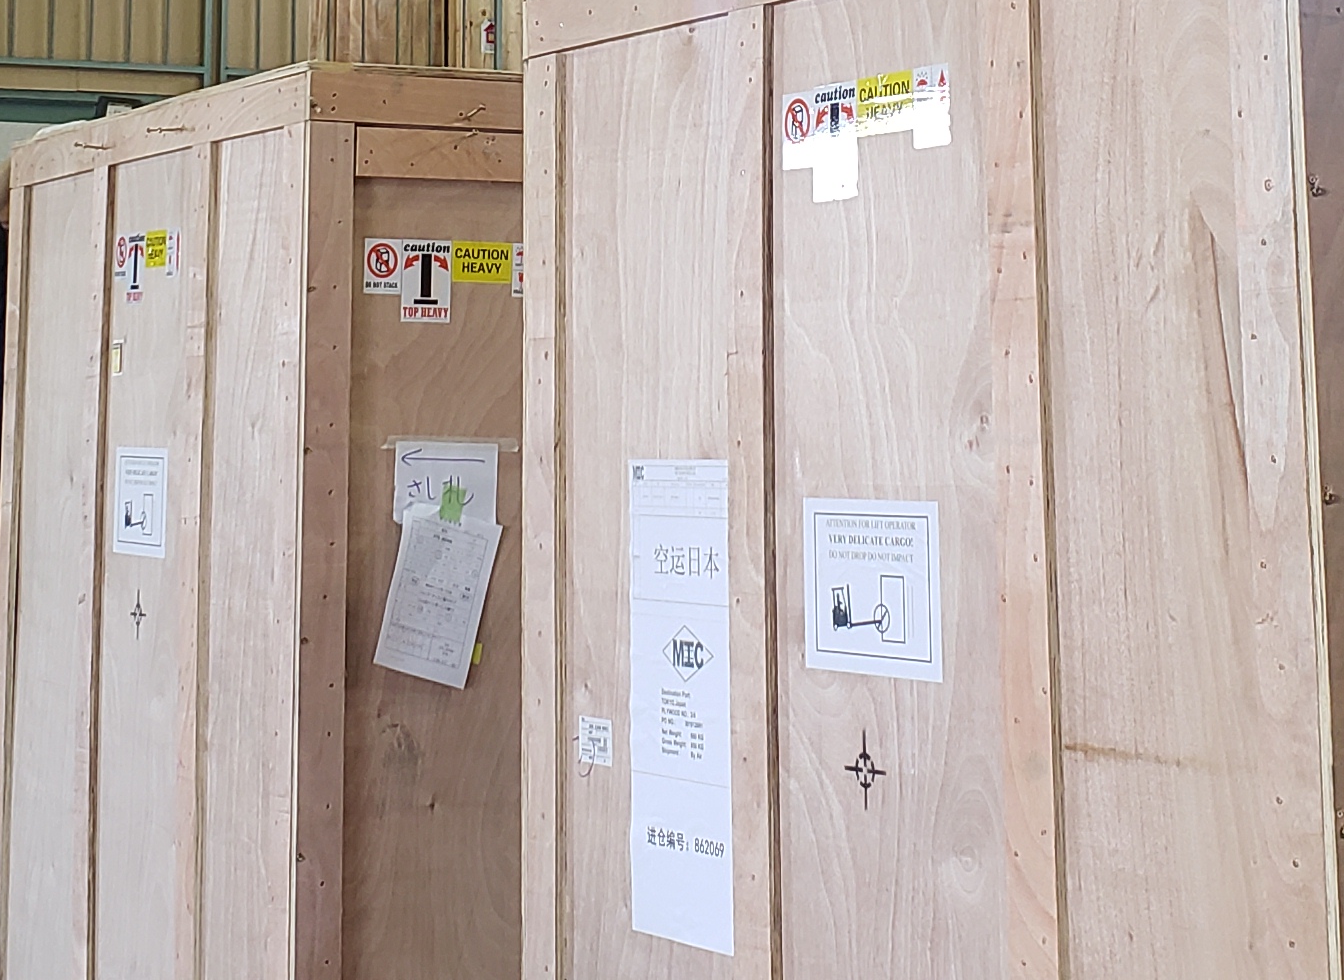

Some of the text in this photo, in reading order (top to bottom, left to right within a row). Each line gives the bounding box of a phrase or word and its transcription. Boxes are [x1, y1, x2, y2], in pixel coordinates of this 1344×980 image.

[814, 85, 856, 104] caution
[859, 80, 910, 103] CAUTION
[403, 242, 451, 254] caution
[455, 247, 509, 261] CAUTION
[461, 262, 502, 274] HEAVY
[403, 307, 449, 319] TOP HEAVY
[884, 521, 916, 530] OPERATOR
[828, 534, 846, 545] VERY
[849, 535, 883, 546] DELICATE
[654, 544, 720, 579] 空运日本
[829, 550, 837, 559] DO
[839, 550, 850, 560] NOT
[868, 552, 876, 561] DO
[878, 552, 889, 561] NOT
[672, 638, 704, 670] MIC
